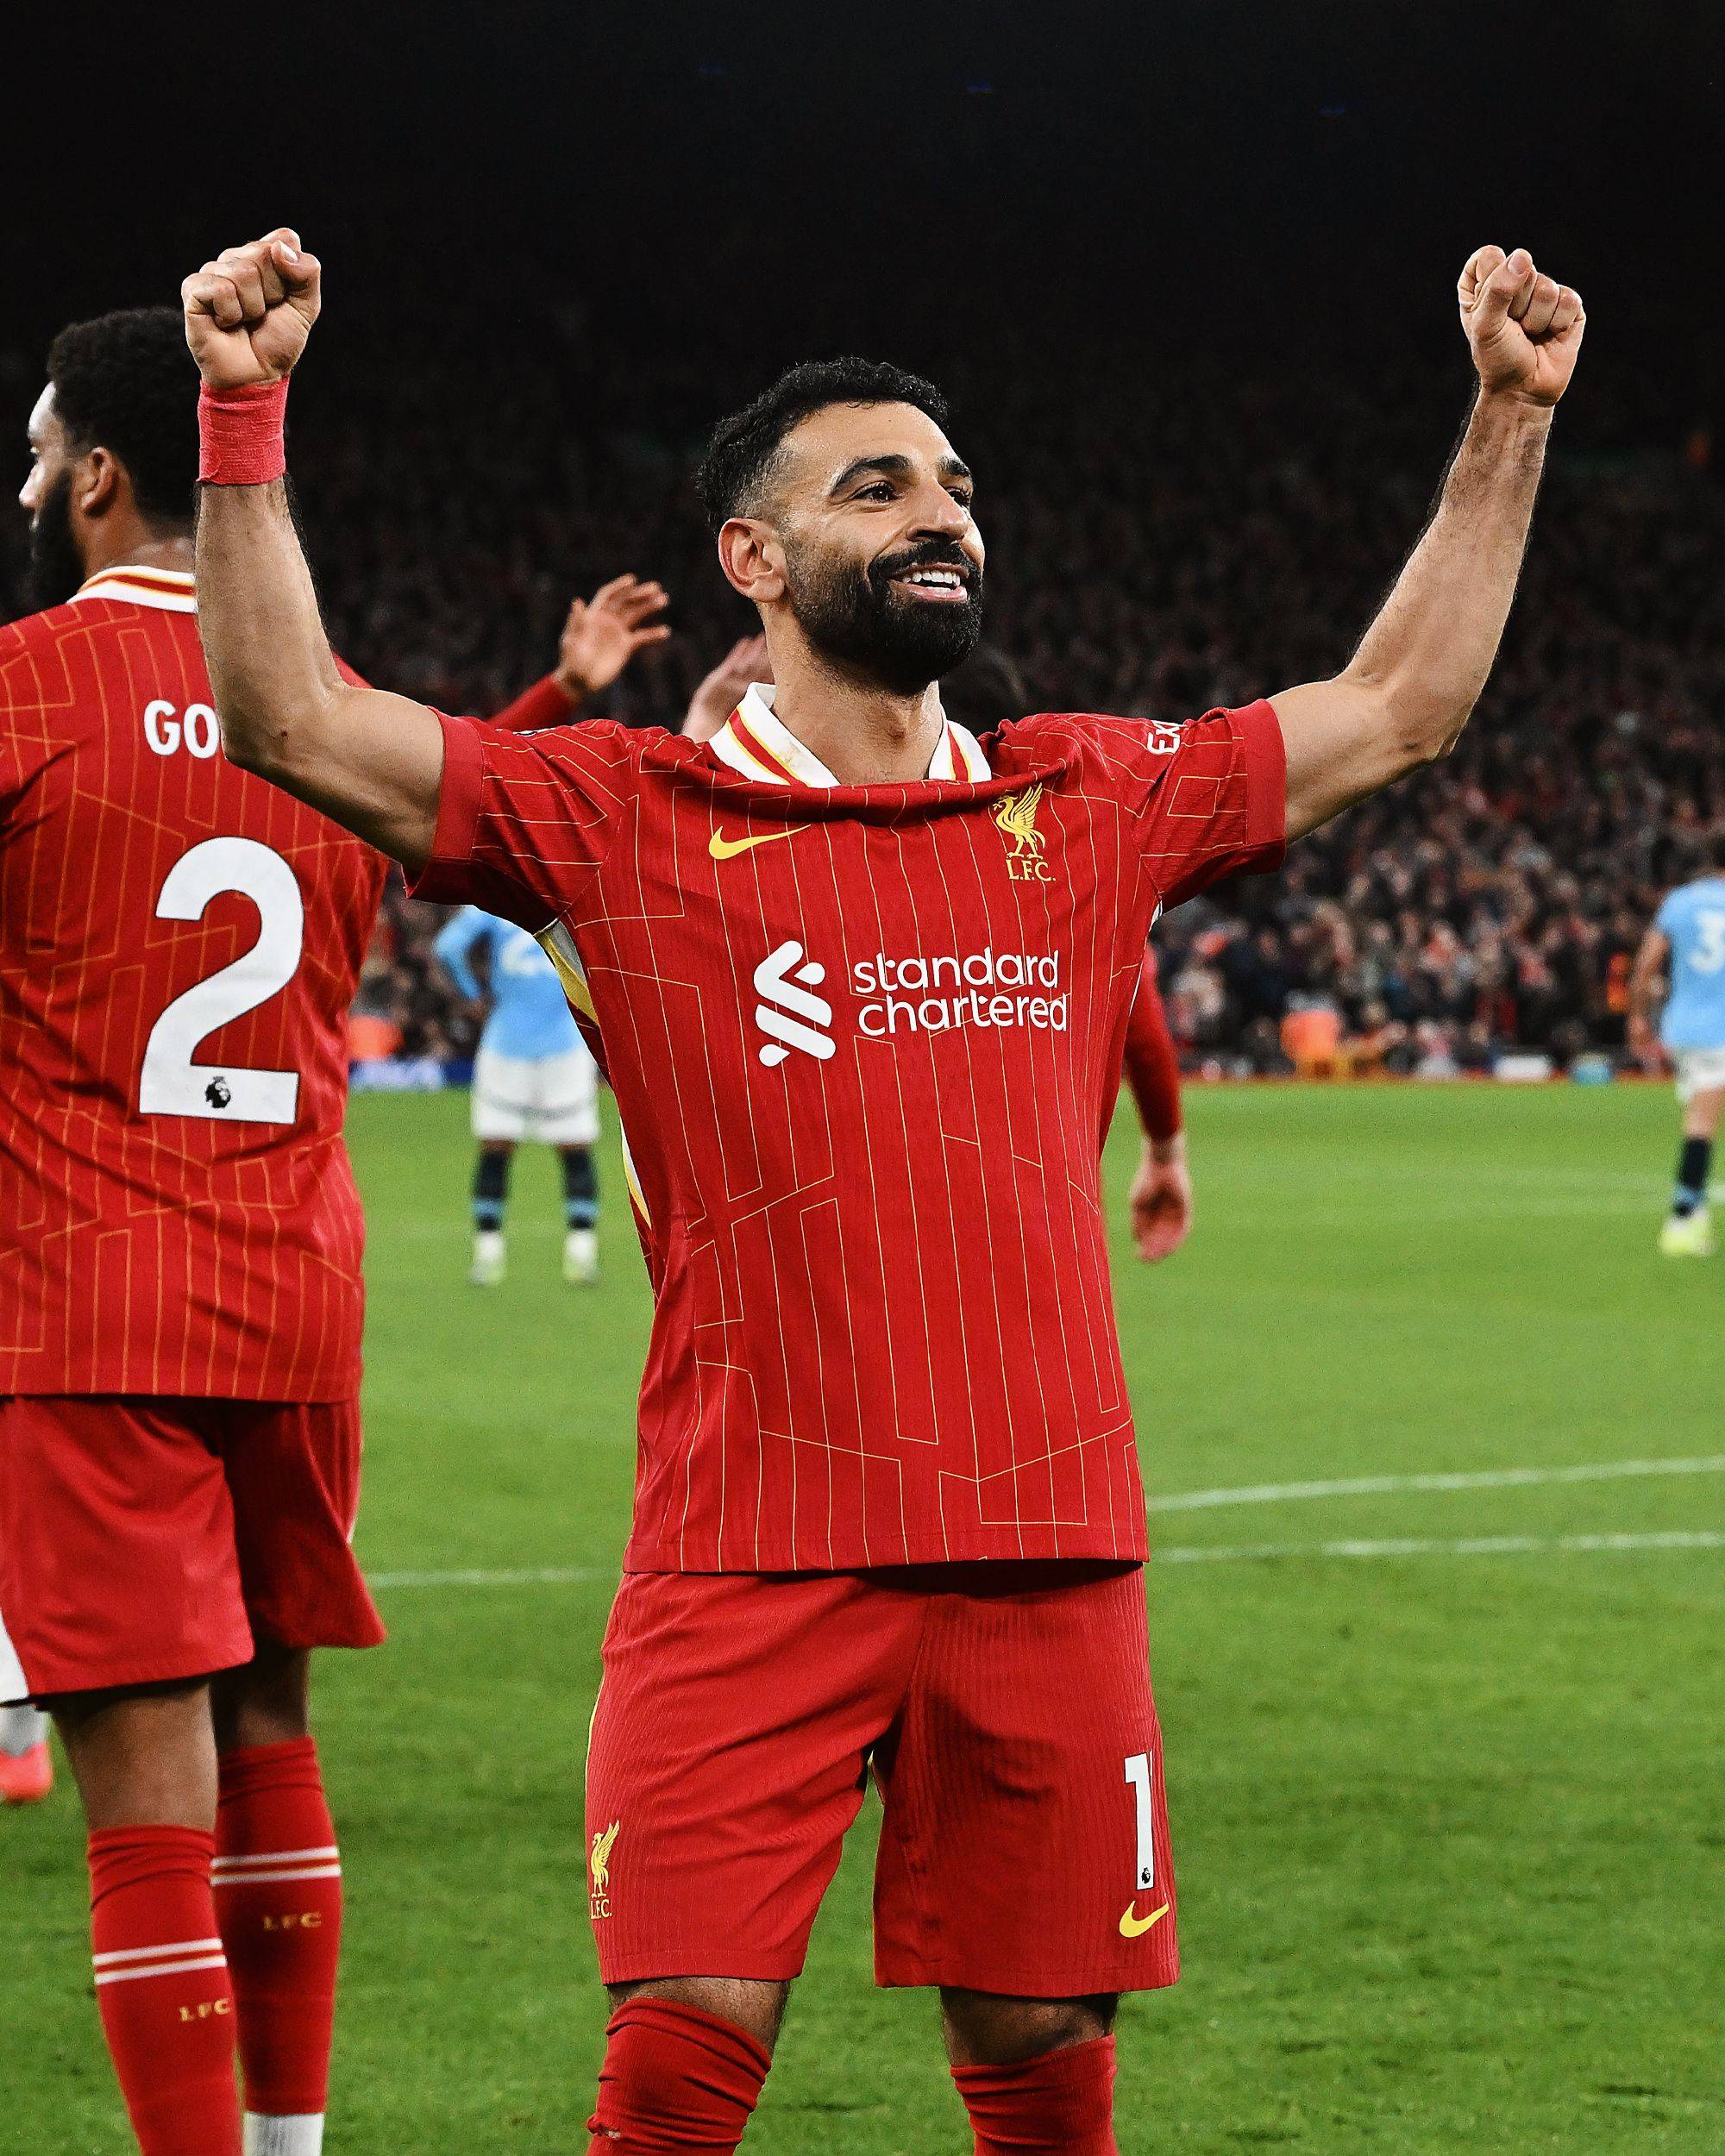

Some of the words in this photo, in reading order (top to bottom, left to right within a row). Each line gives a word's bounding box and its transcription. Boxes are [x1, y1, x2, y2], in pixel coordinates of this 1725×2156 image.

[1147, 720, 1188, 755] EX
[1006, 859, 1057, 881] L.F.C.
[139, 836, 304, 1125] 2
[853, 946, 1059, 993] standard
[858, 988, 1068, 1037] chartered
[263, 1911, 322, 1931] LFC
